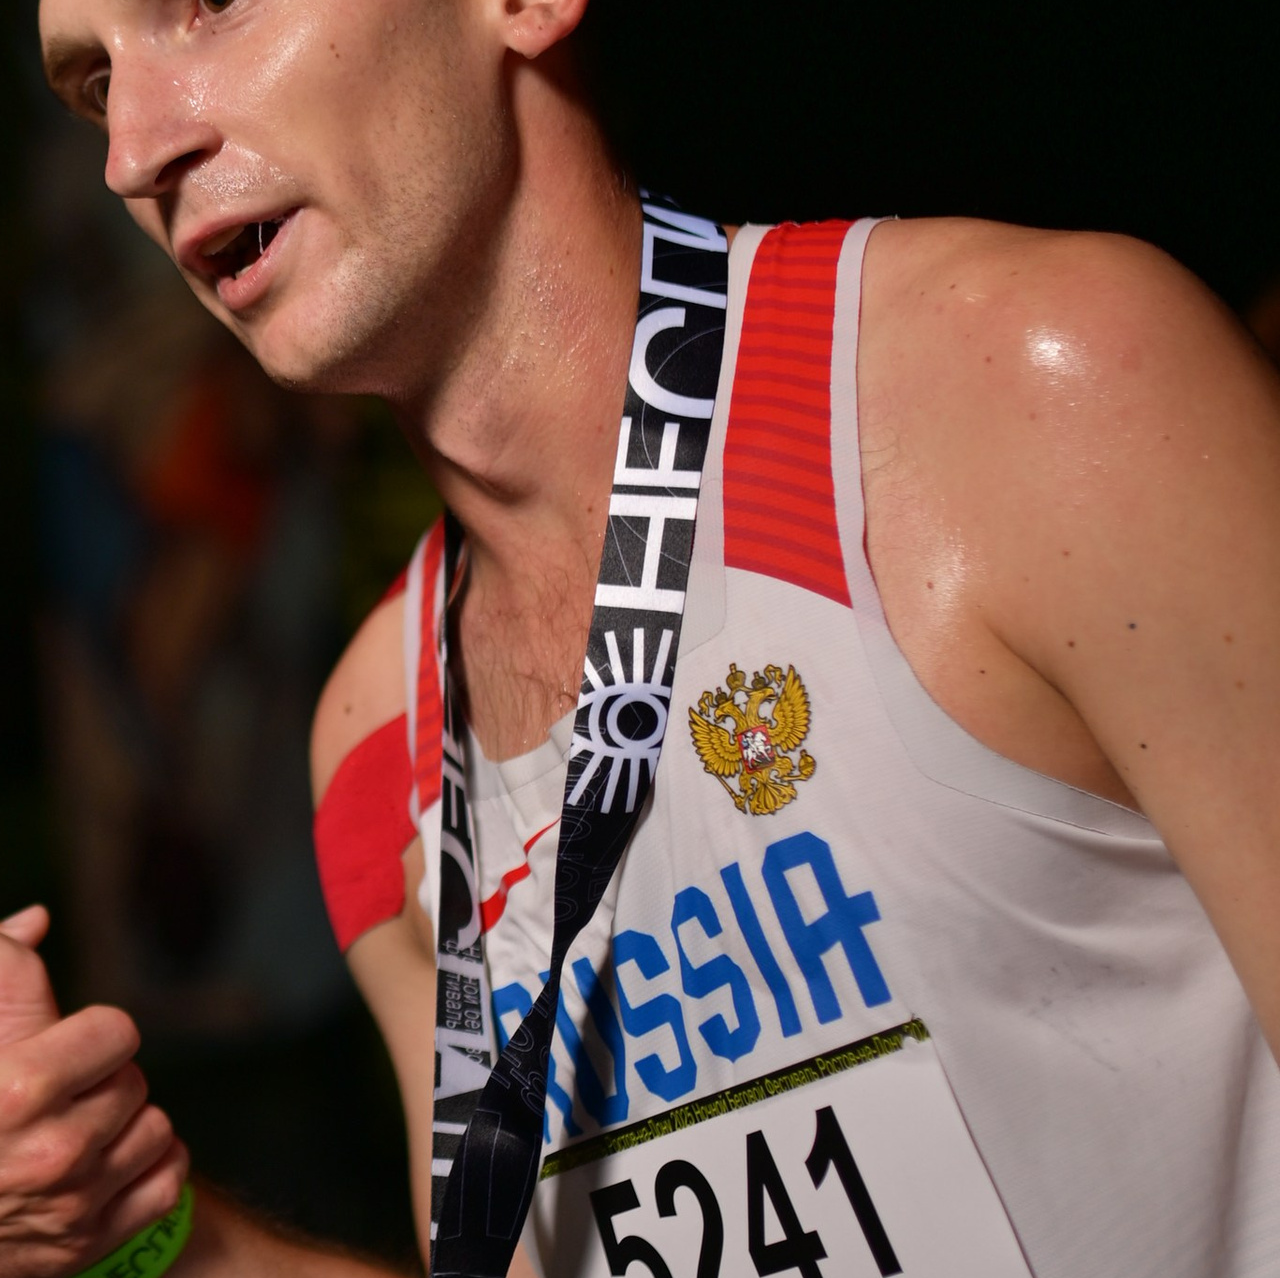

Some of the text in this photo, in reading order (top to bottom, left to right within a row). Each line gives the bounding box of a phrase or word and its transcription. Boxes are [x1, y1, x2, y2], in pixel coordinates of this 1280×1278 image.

[491, 831, 893, 1145] RUSSIA
[692, 1095, 727, 1125] Ночной
[726, 1081, 766, 1114] Беговой
[764, 1067, 819, 1097] Фестиваль
